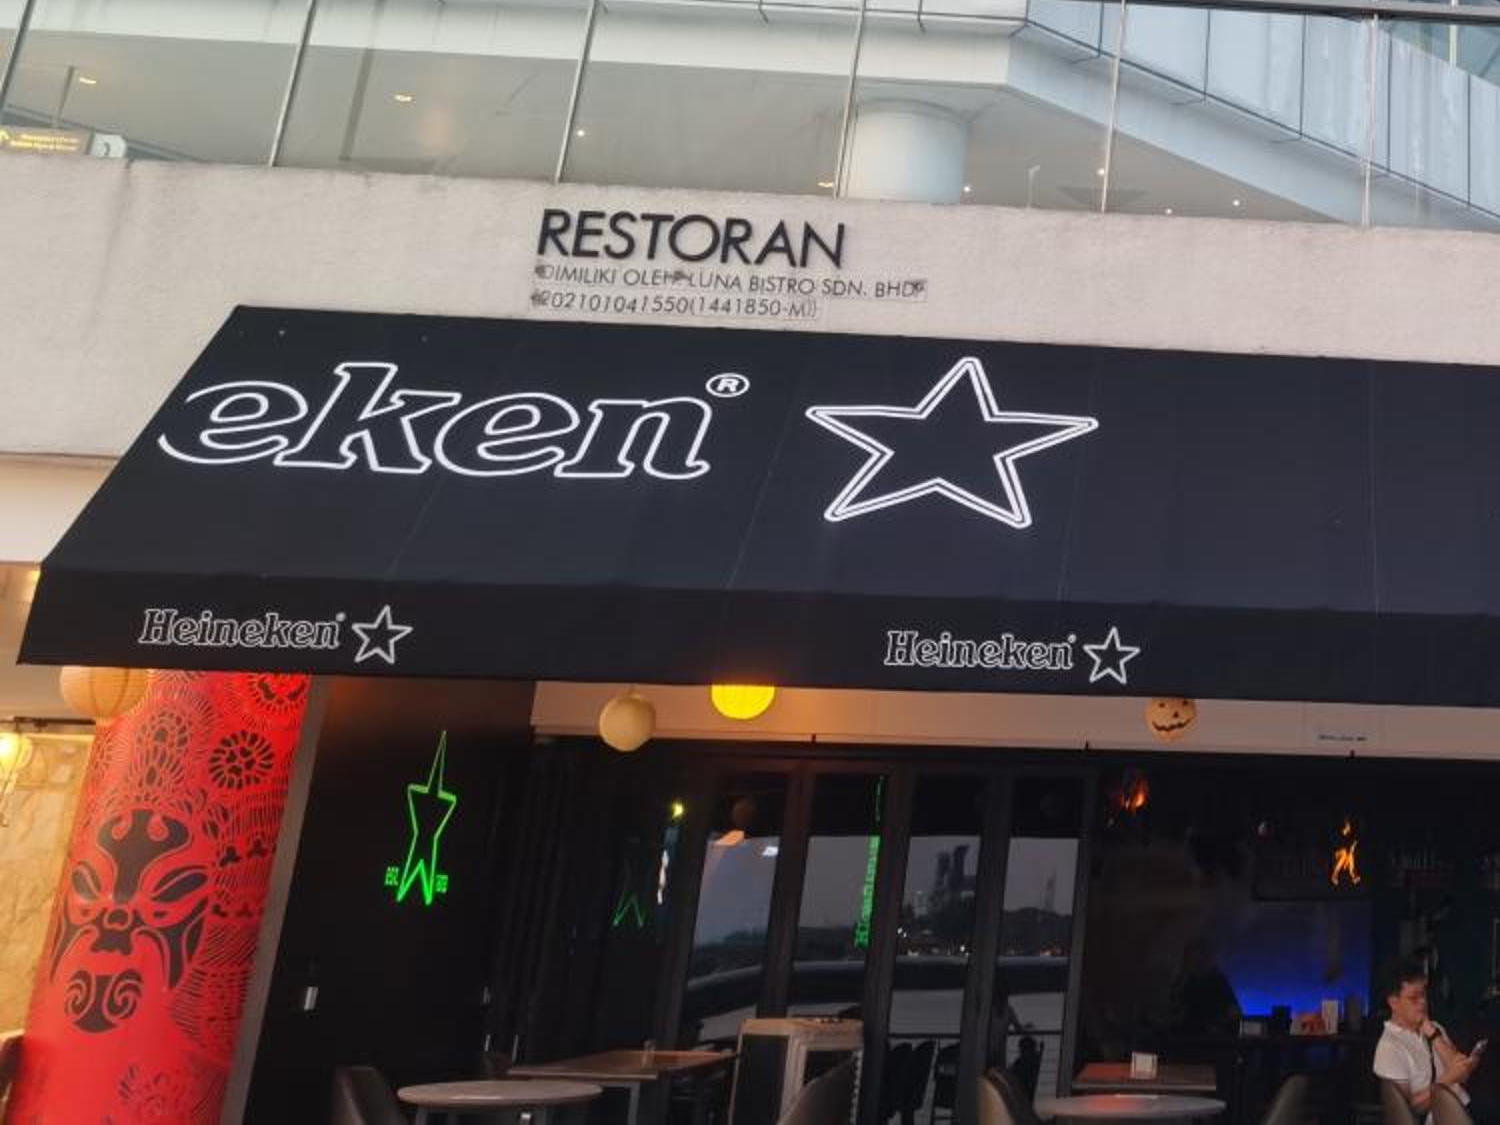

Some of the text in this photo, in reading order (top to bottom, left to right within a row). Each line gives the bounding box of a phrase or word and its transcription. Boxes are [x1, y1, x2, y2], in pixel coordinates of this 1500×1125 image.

[537, 208, 846, 269] RESTORAN
[540, 264, 616, 286] DIMILIKI
[624, 268, 675, 287] OLEH
[688, 271, 742, 290] LUNA
[750, 276, 816, 296] BISTRO
[822, 278, 867, 297] SDN.
